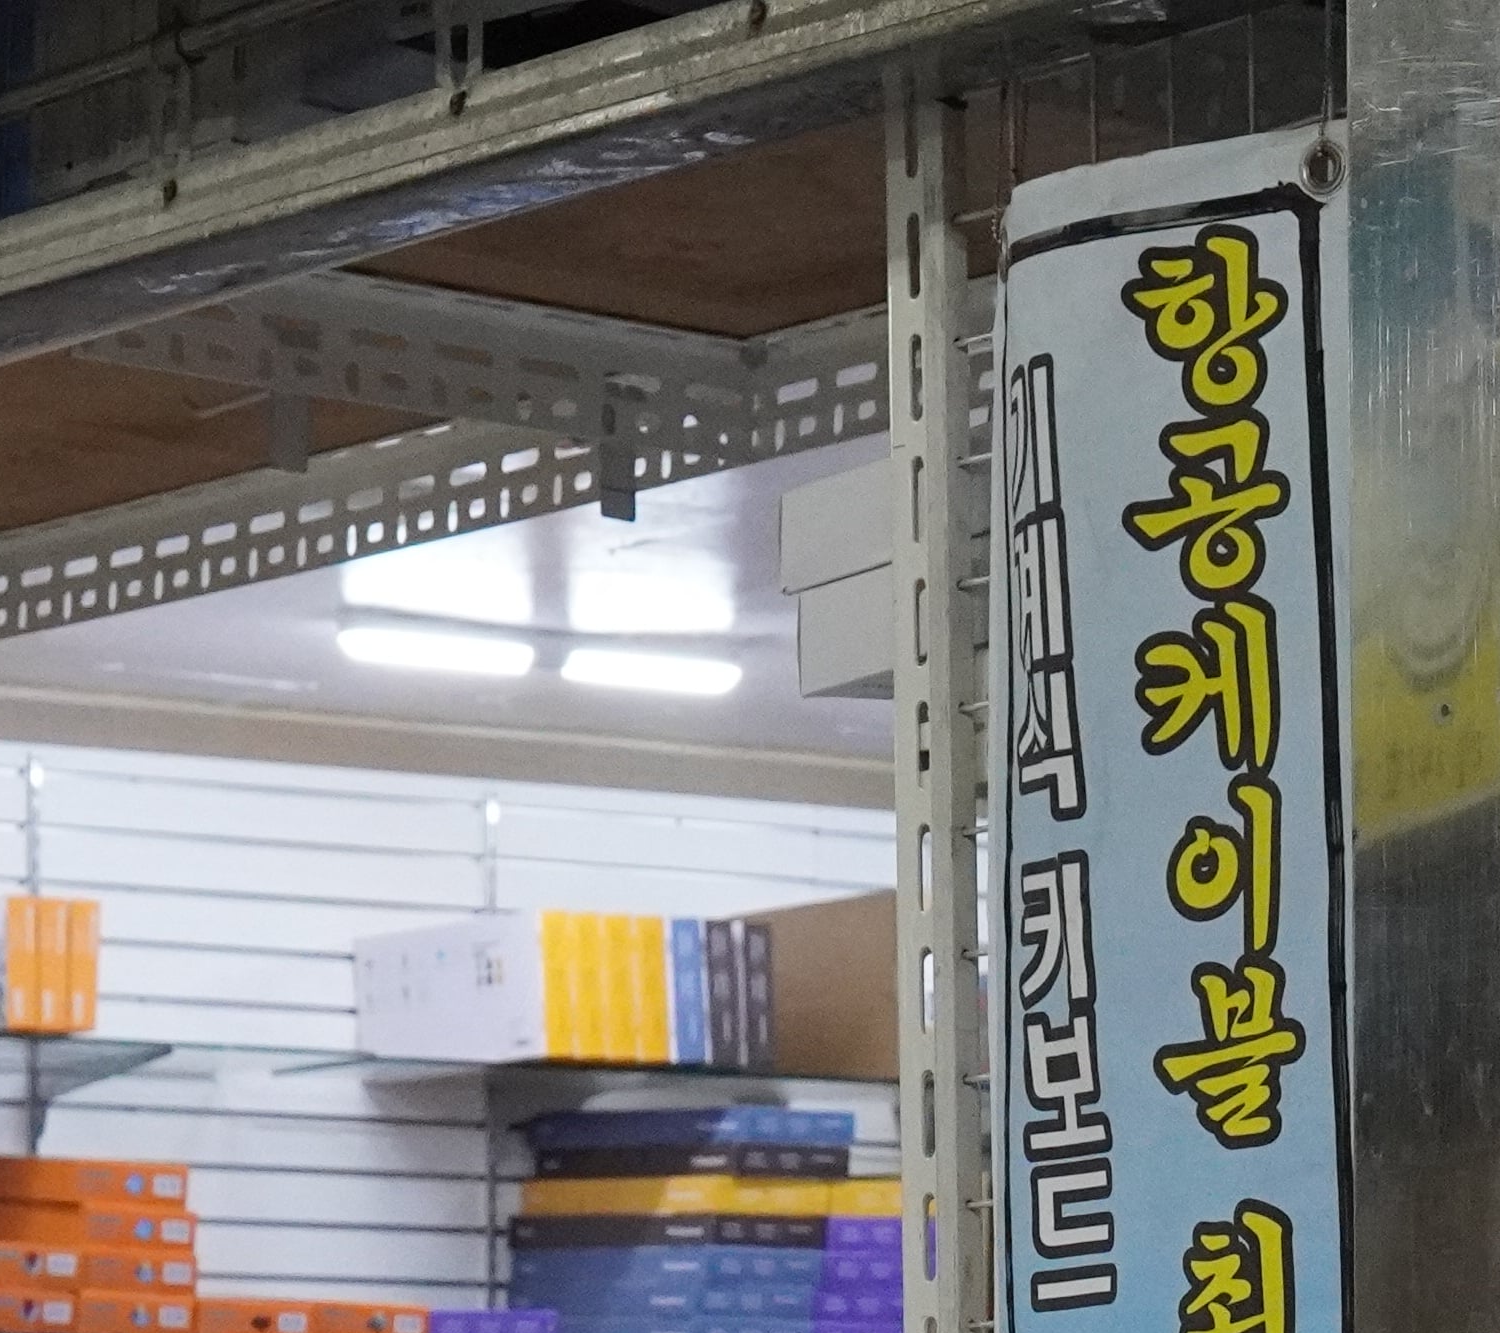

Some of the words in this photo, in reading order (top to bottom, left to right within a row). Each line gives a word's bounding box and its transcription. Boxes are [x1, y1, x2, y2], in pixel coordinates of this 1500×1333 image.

[1008, 352, 1086, 822] 기계식
[1121, 225, 1308, 1149] 항공케이블
[1018, 848, 1116, 1313] 키보드
